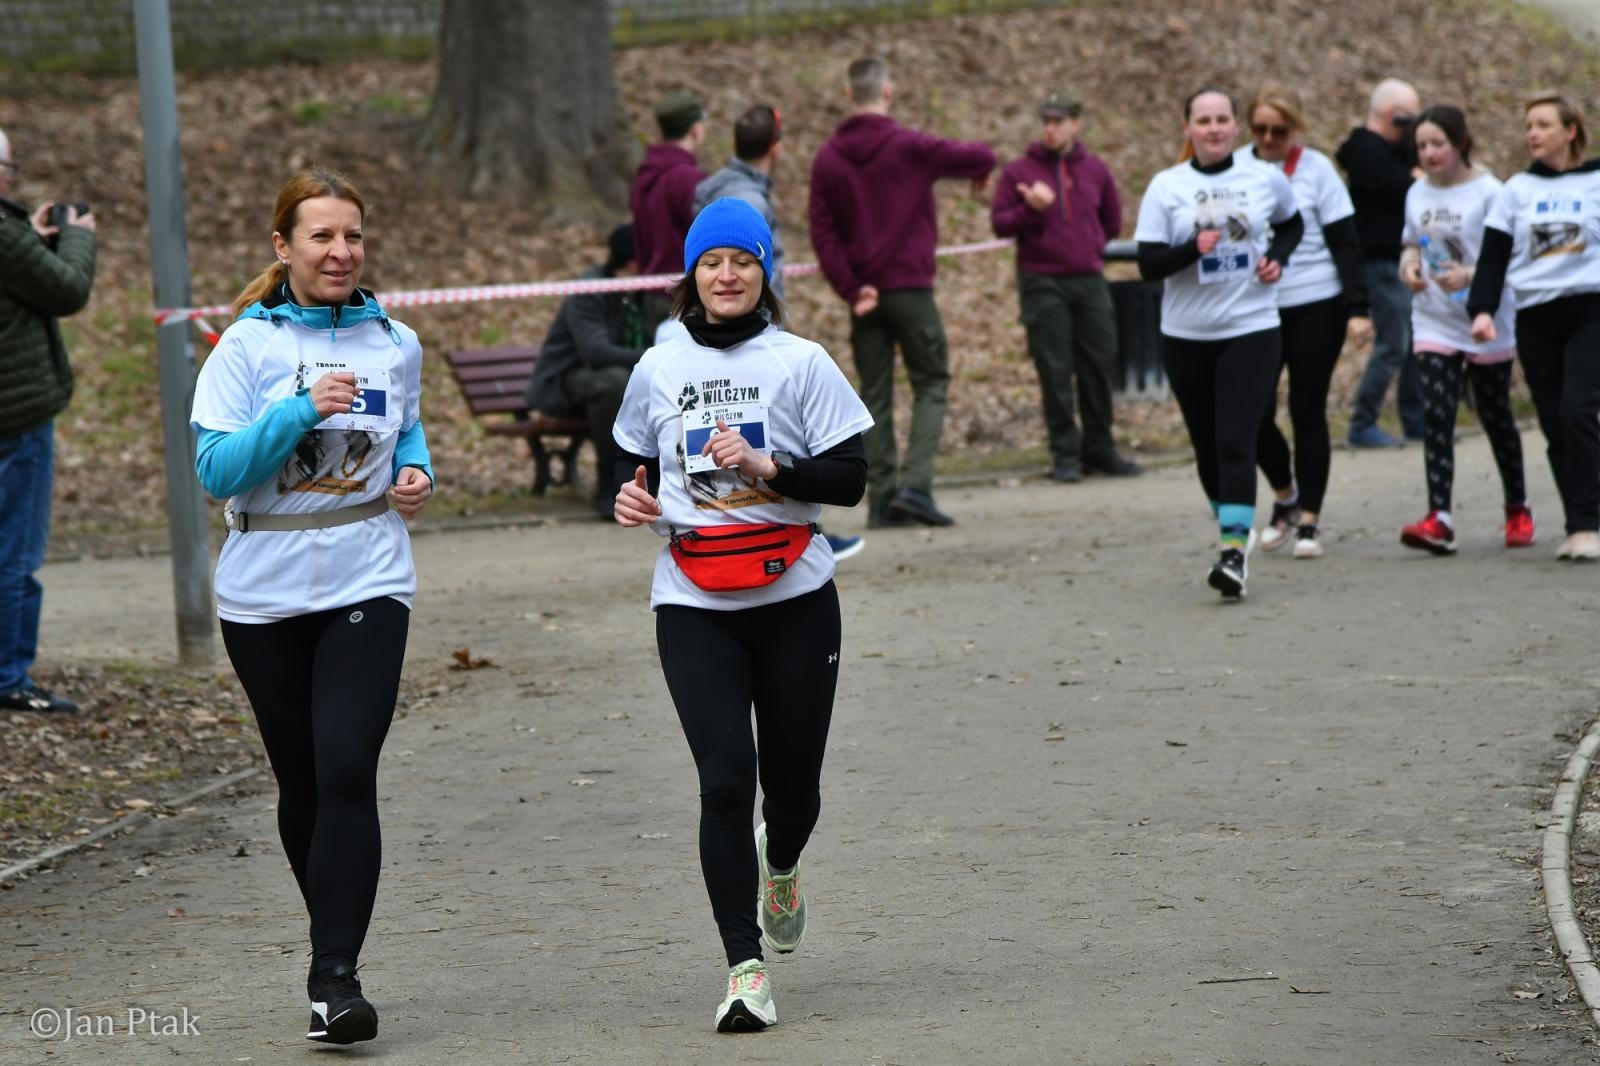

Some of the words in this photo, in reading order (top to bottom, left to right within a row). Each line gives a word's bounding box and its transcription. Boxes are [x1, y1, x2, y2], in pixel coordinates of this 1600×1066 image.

[1218, 254, 1238, 272] 26
[702, 379, 731, 390] TROPEM
[351, 390, 367, 413] 5
[703, 387, 760, 405] WILCZYM
[714, 412, 743, 421] WILCZYM
